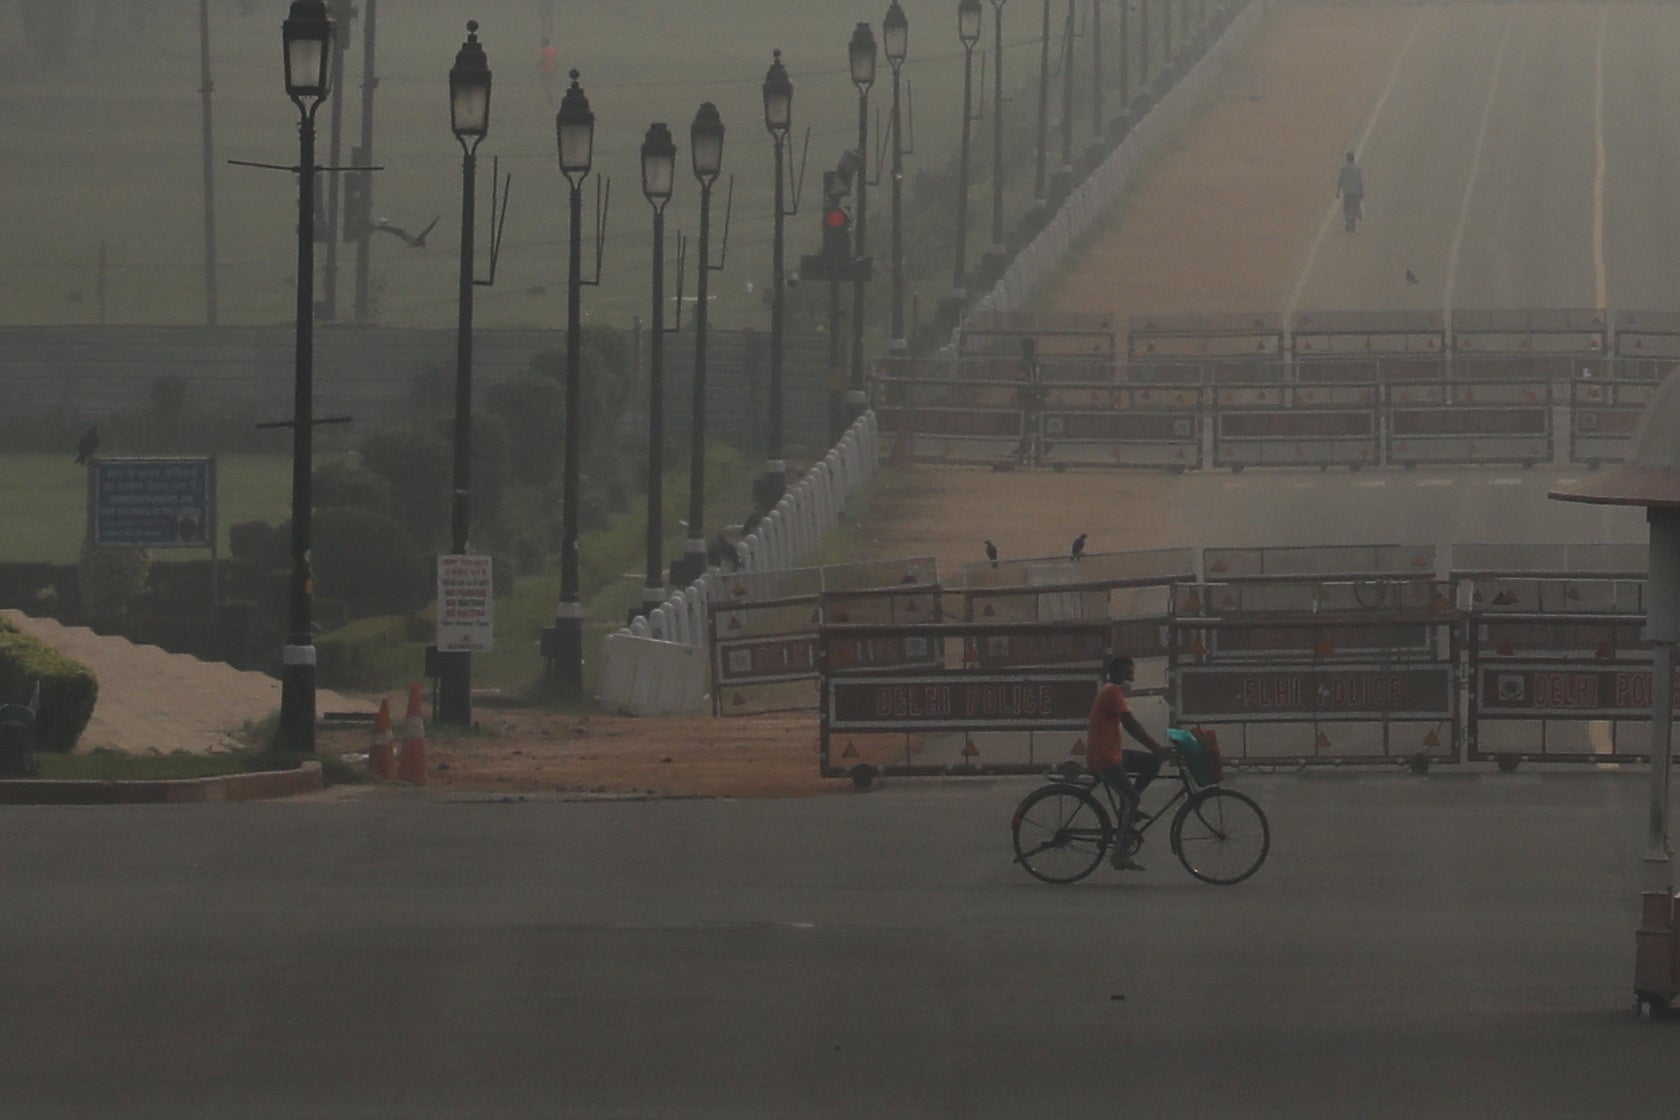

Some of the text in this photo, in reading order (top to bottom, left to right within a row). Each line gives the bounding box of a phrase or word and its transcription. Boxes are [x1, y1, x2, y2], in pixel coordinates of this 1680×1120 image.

[877, 685, 1053, 716] DELHI POLICE
[1533, 673, 1599, 708] DELHI
